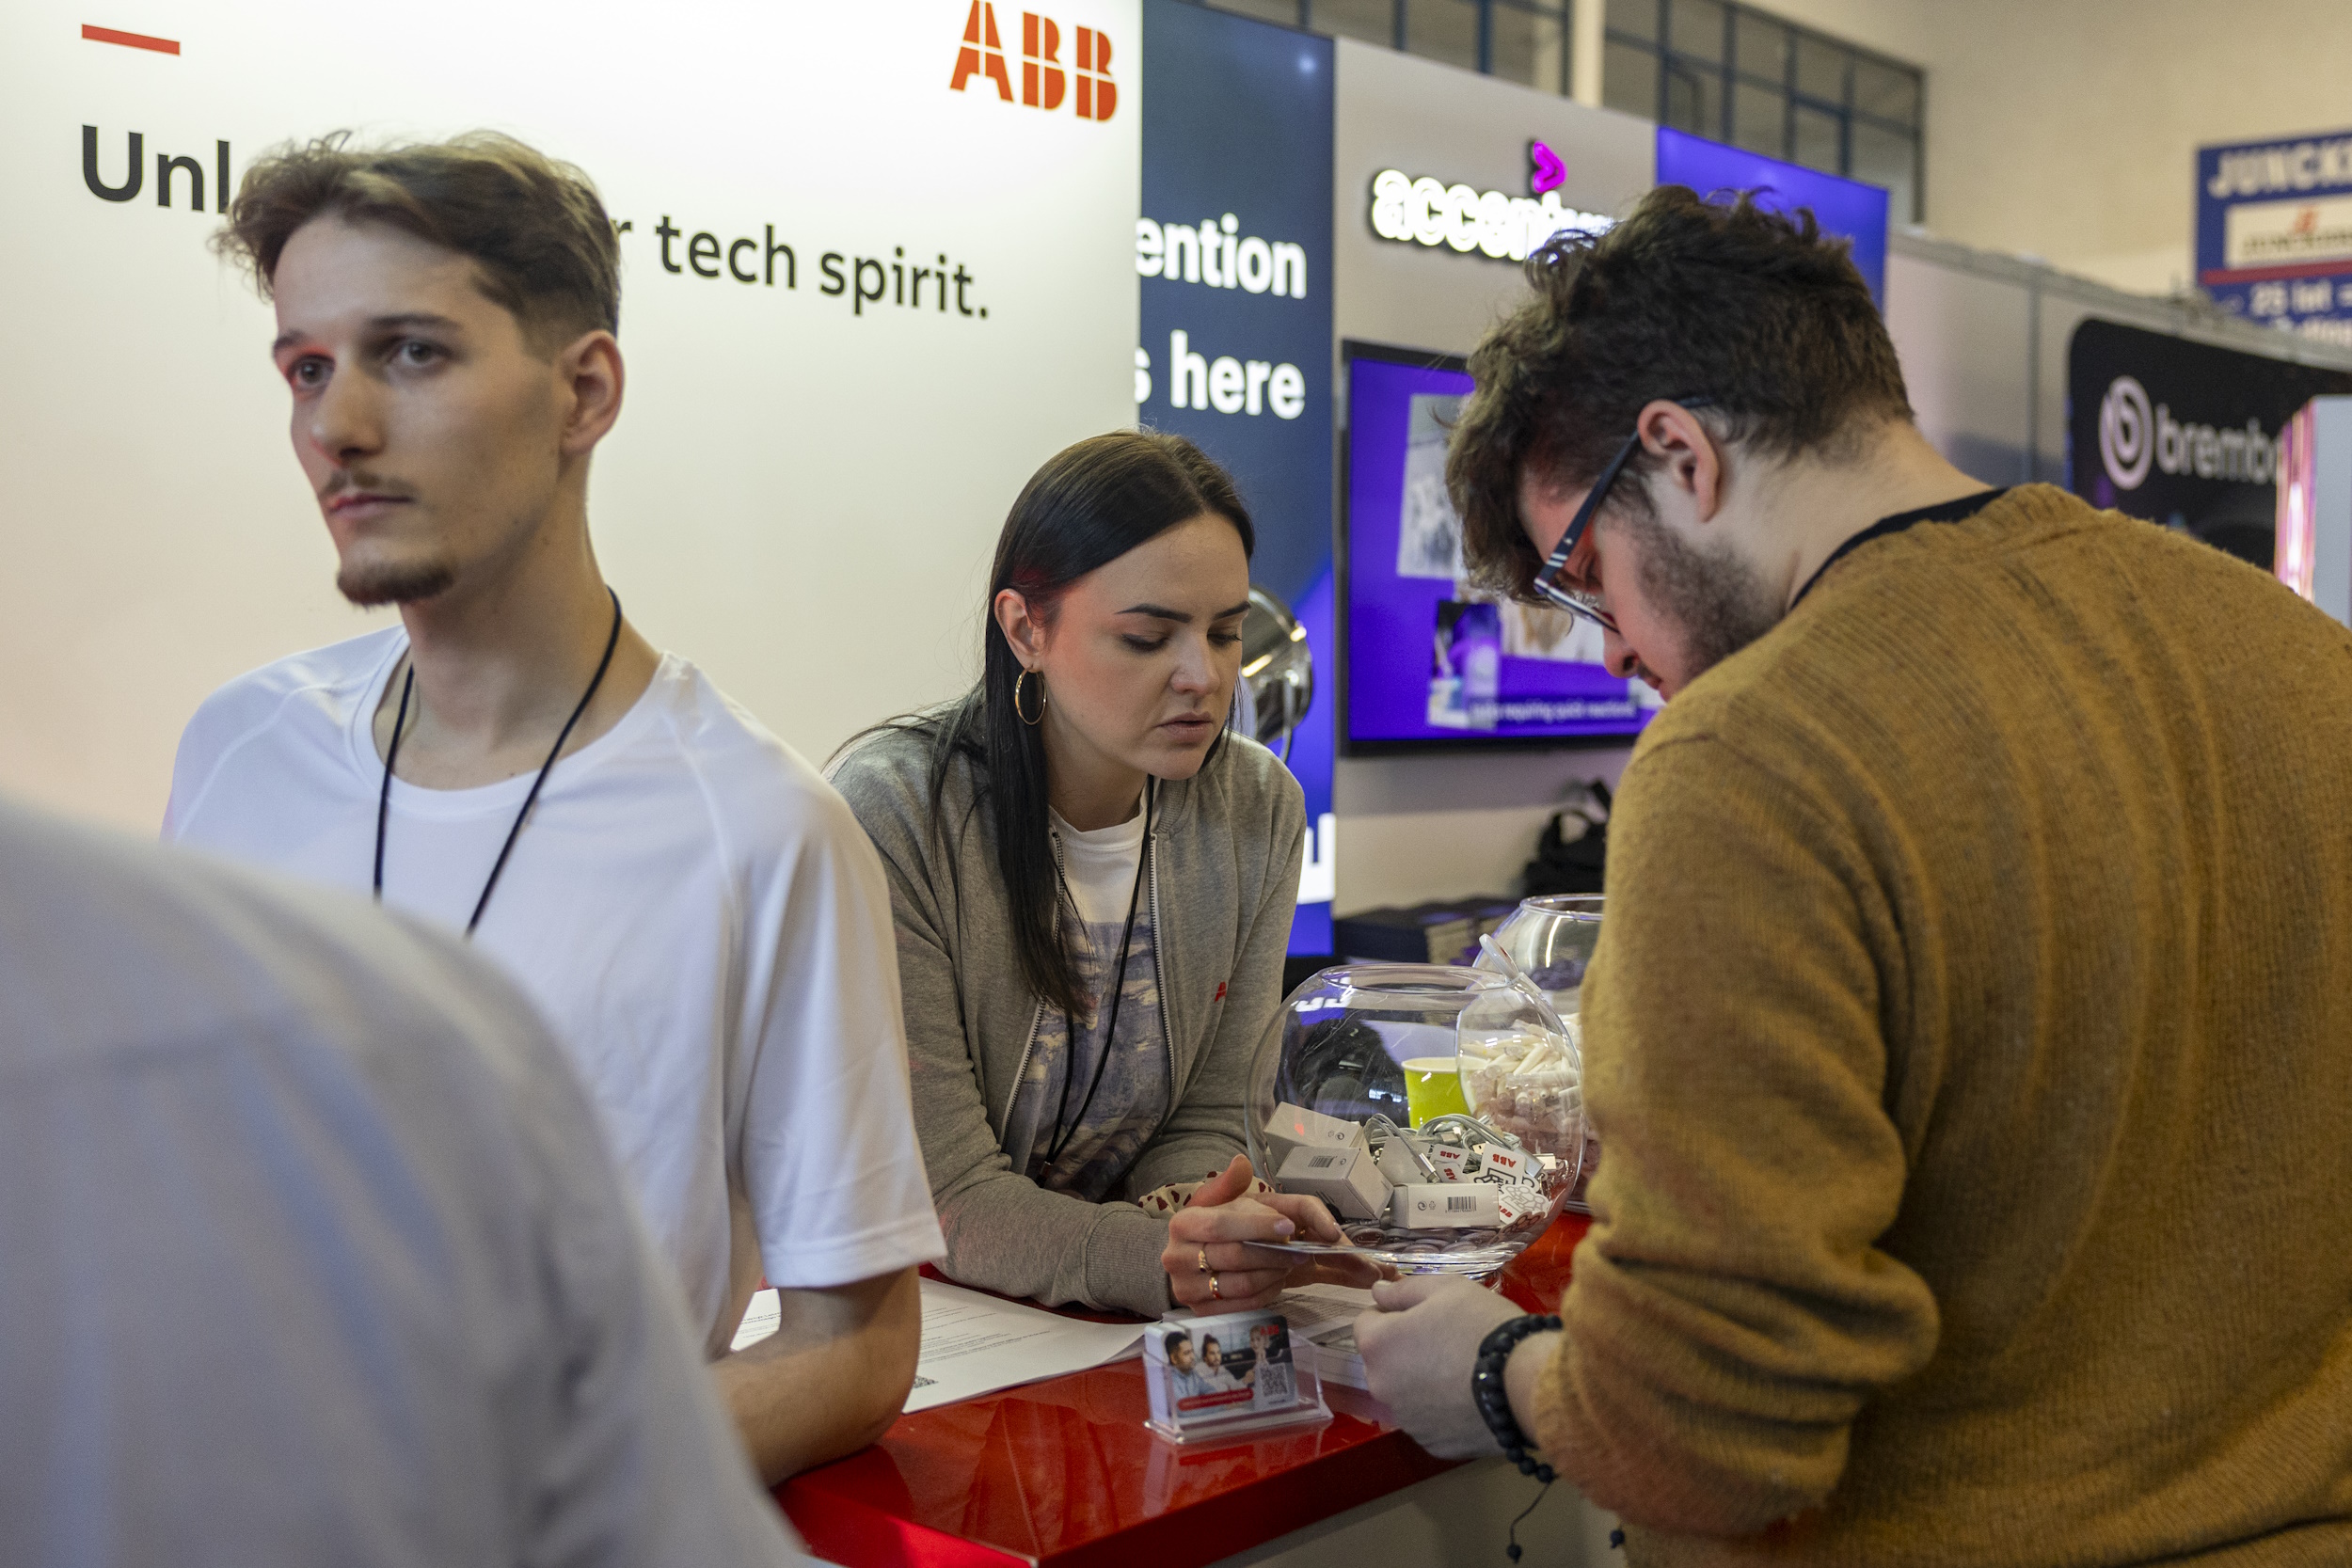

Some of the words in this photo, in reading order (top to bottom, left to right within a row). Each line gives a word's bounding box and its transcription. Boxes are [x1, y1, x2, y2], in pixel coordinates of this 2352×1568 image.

[949, 0, 1119, 122] ABB
[82, 124, 230, 214] Unl
[656, 215, 797, 290] tech
[819, 245, 989, 319] spirit.
[1136, 213, 1307, 299] ention
[1135, 346, 1152, 404] s
[1170, 329, 1306, 420] here
[1439, 1150, 1460, 1160] ABB
[1443, 1167, 1457, 1180] ABB
[1492, 1153, 1517, 1168] ABB
